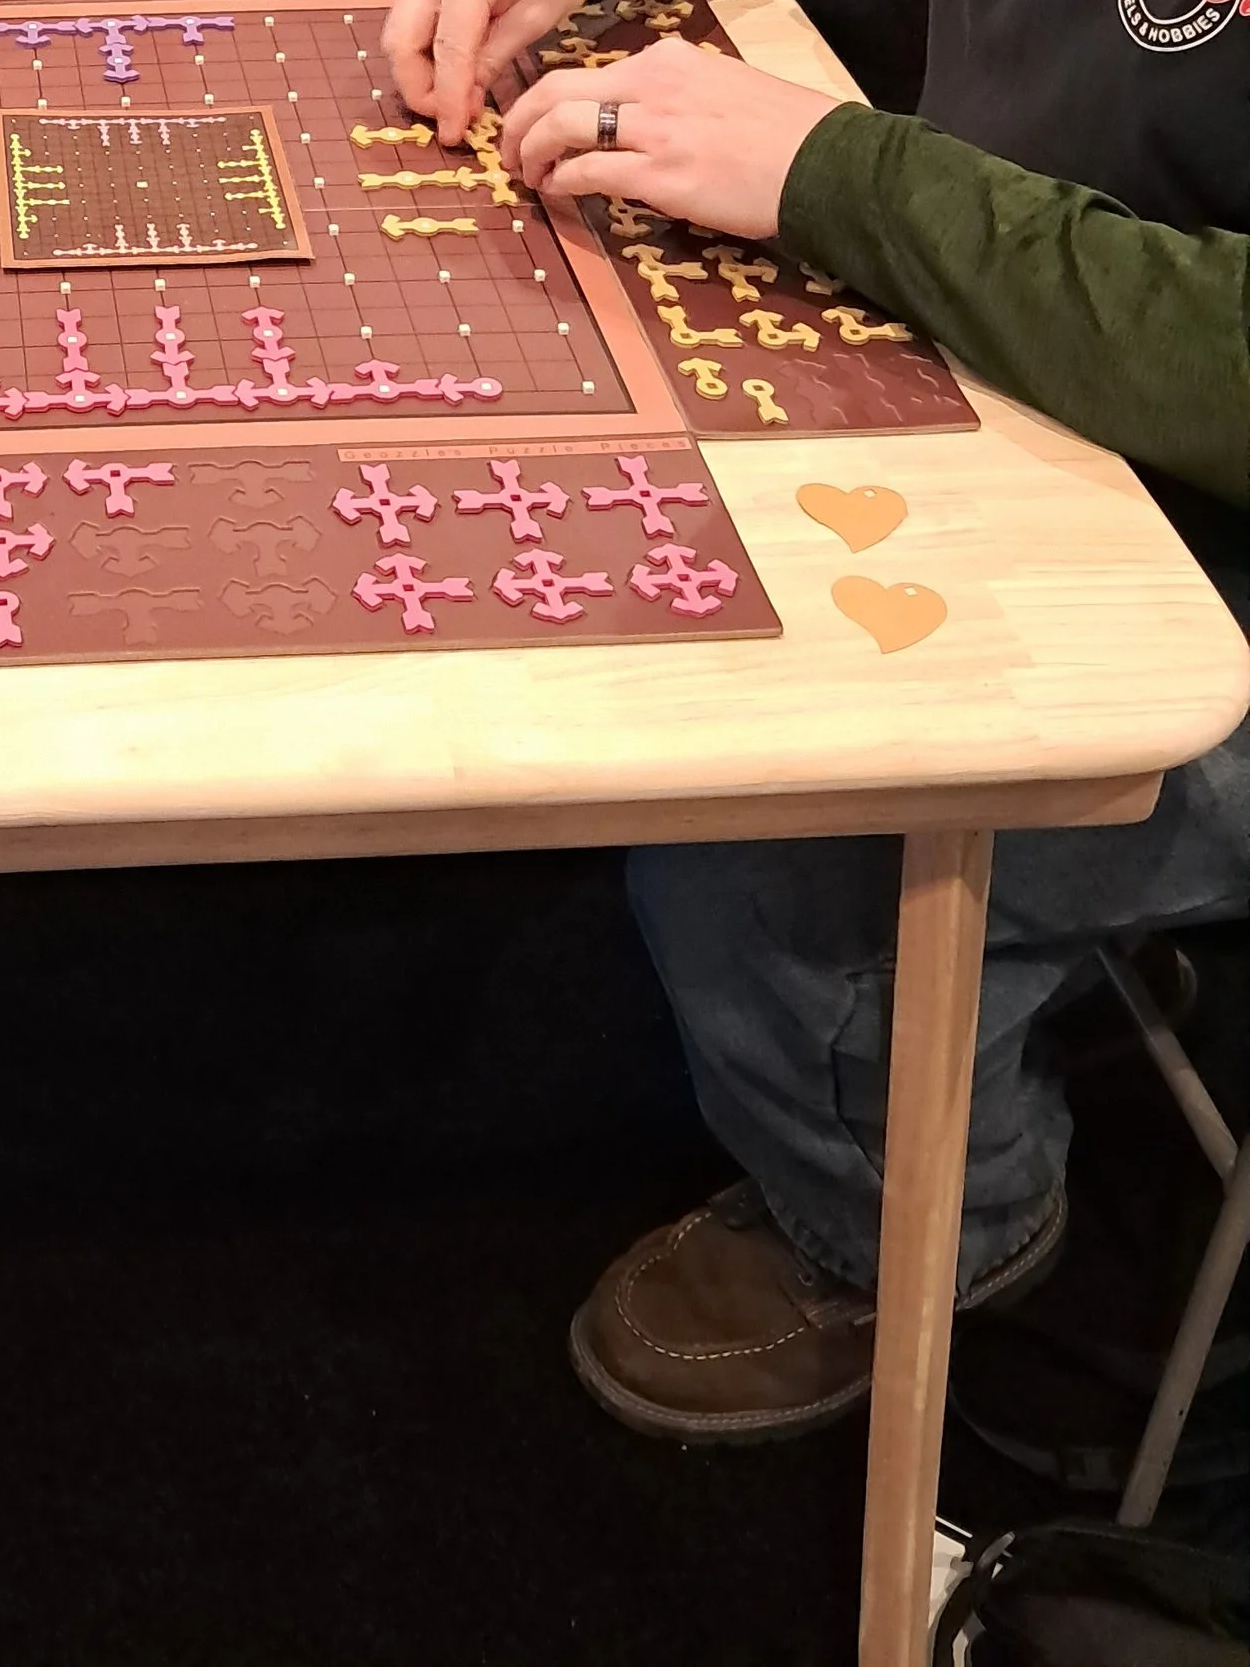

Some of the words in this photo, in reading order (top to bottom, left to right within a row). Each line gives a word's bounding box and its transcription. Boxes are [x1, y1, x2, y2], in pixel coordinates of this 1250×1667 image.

[1139, 23, 1149, 36] &
[1148, 7, 1221, 43] HOBBIES
[488, 444, 574, 456] Puzzle
[600, 439, 686, 451] Pieces
